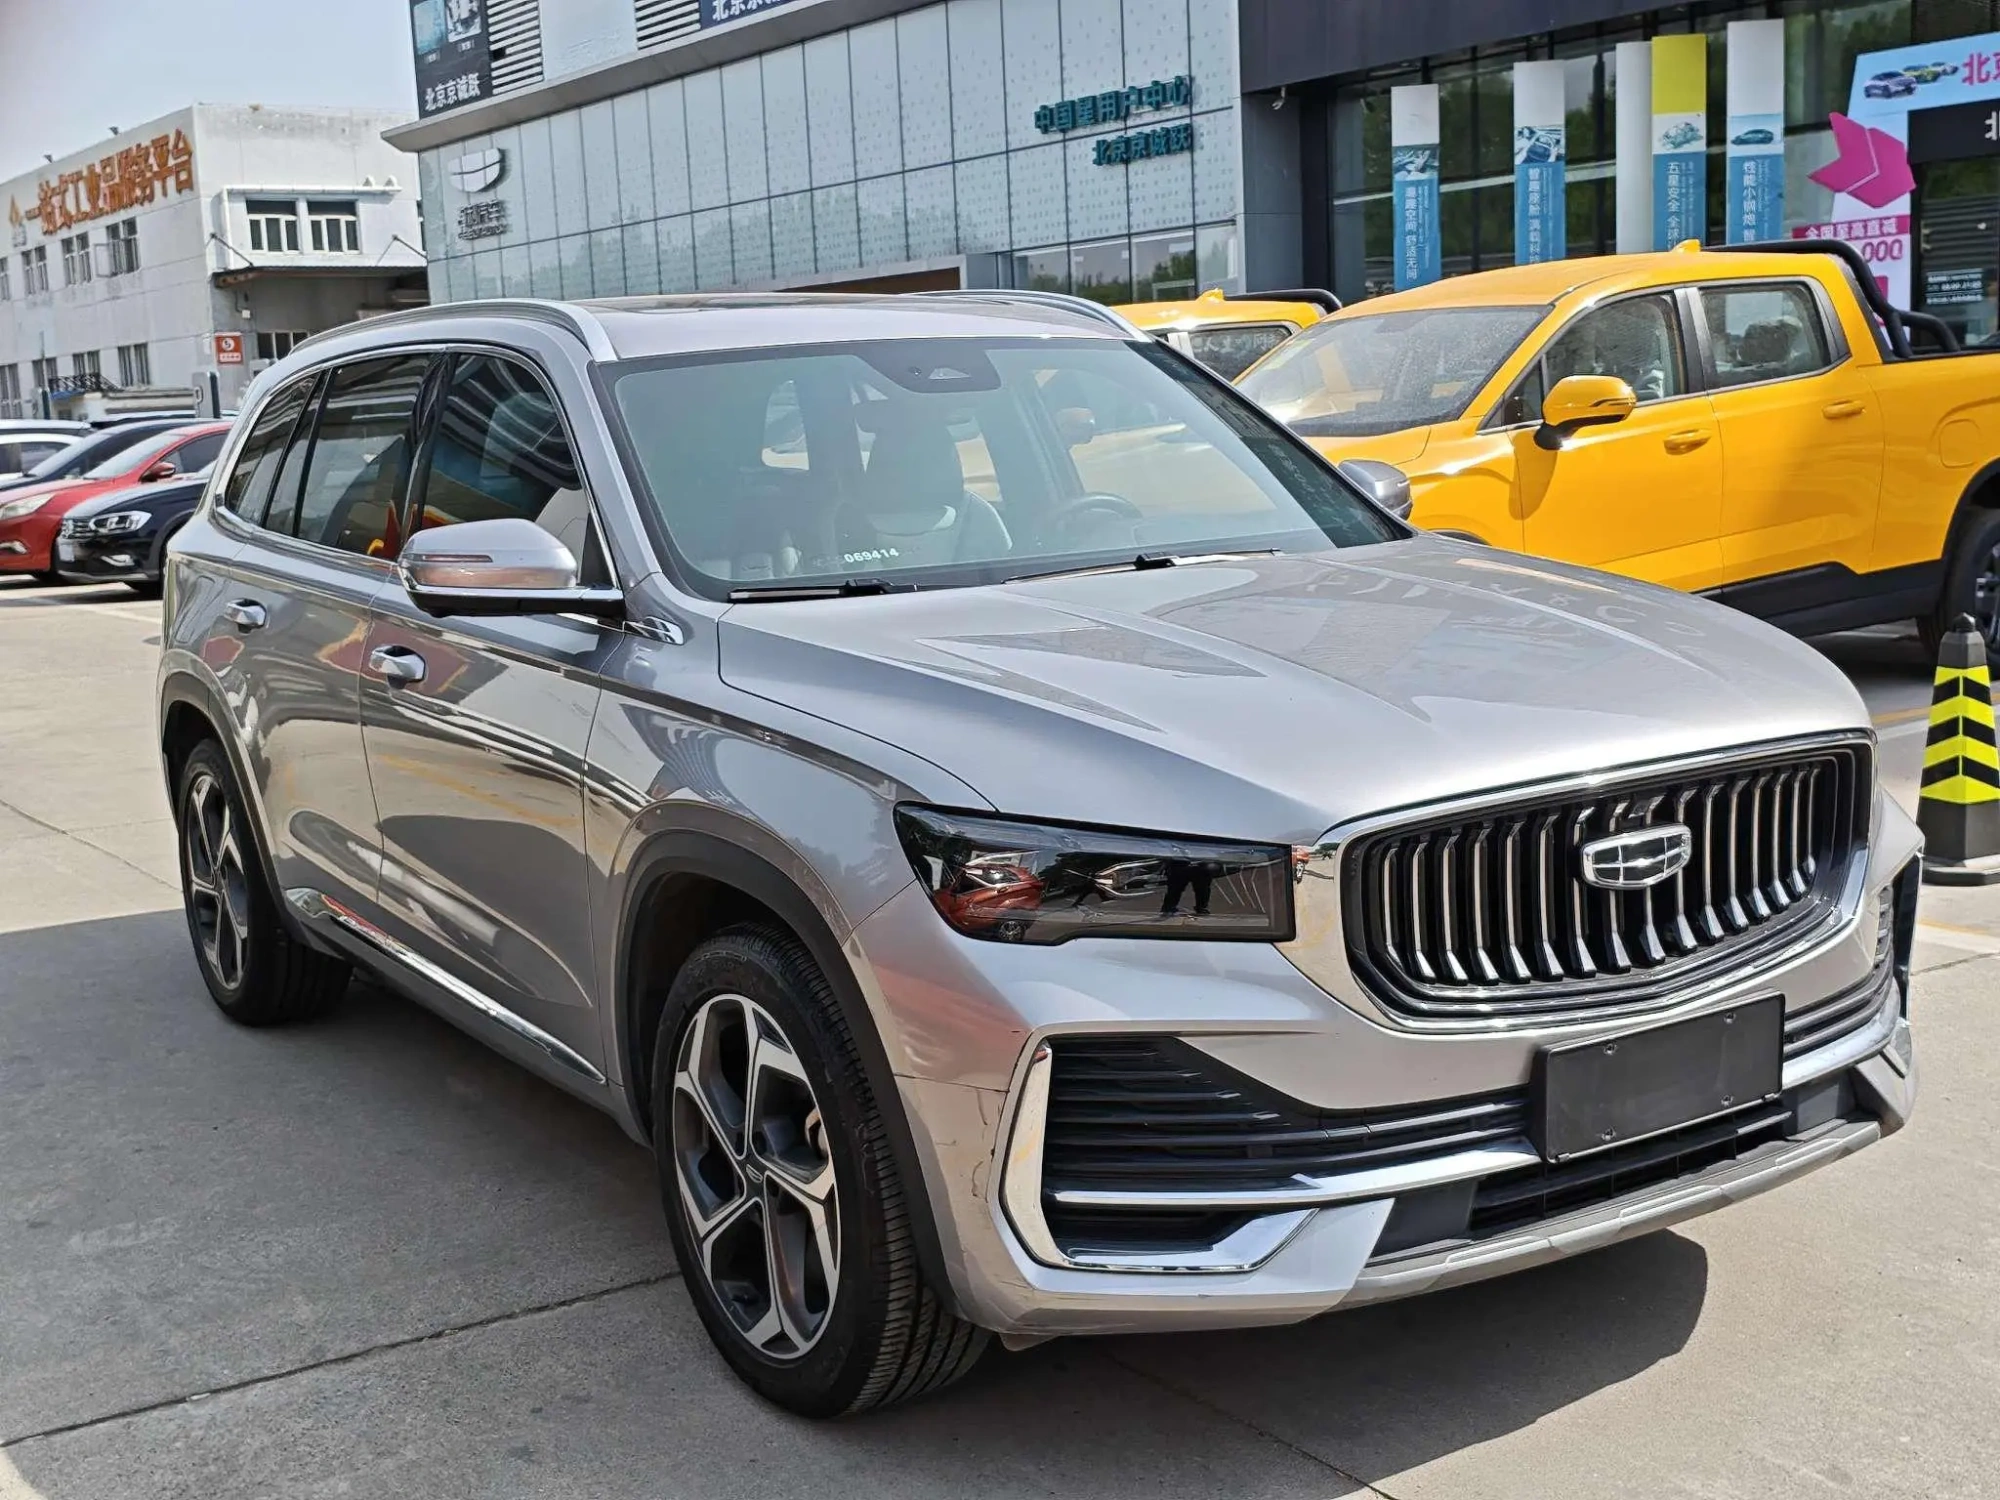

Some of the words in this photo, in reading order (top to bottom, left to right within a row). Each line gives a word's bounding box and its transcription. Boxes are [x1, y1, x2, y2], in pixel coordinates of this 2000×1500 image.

[1962, 51, 2000, 86] 北
[1034, 75, 1191, 134] 中国星用户中心
[843, 547, 899, 563] 069414
